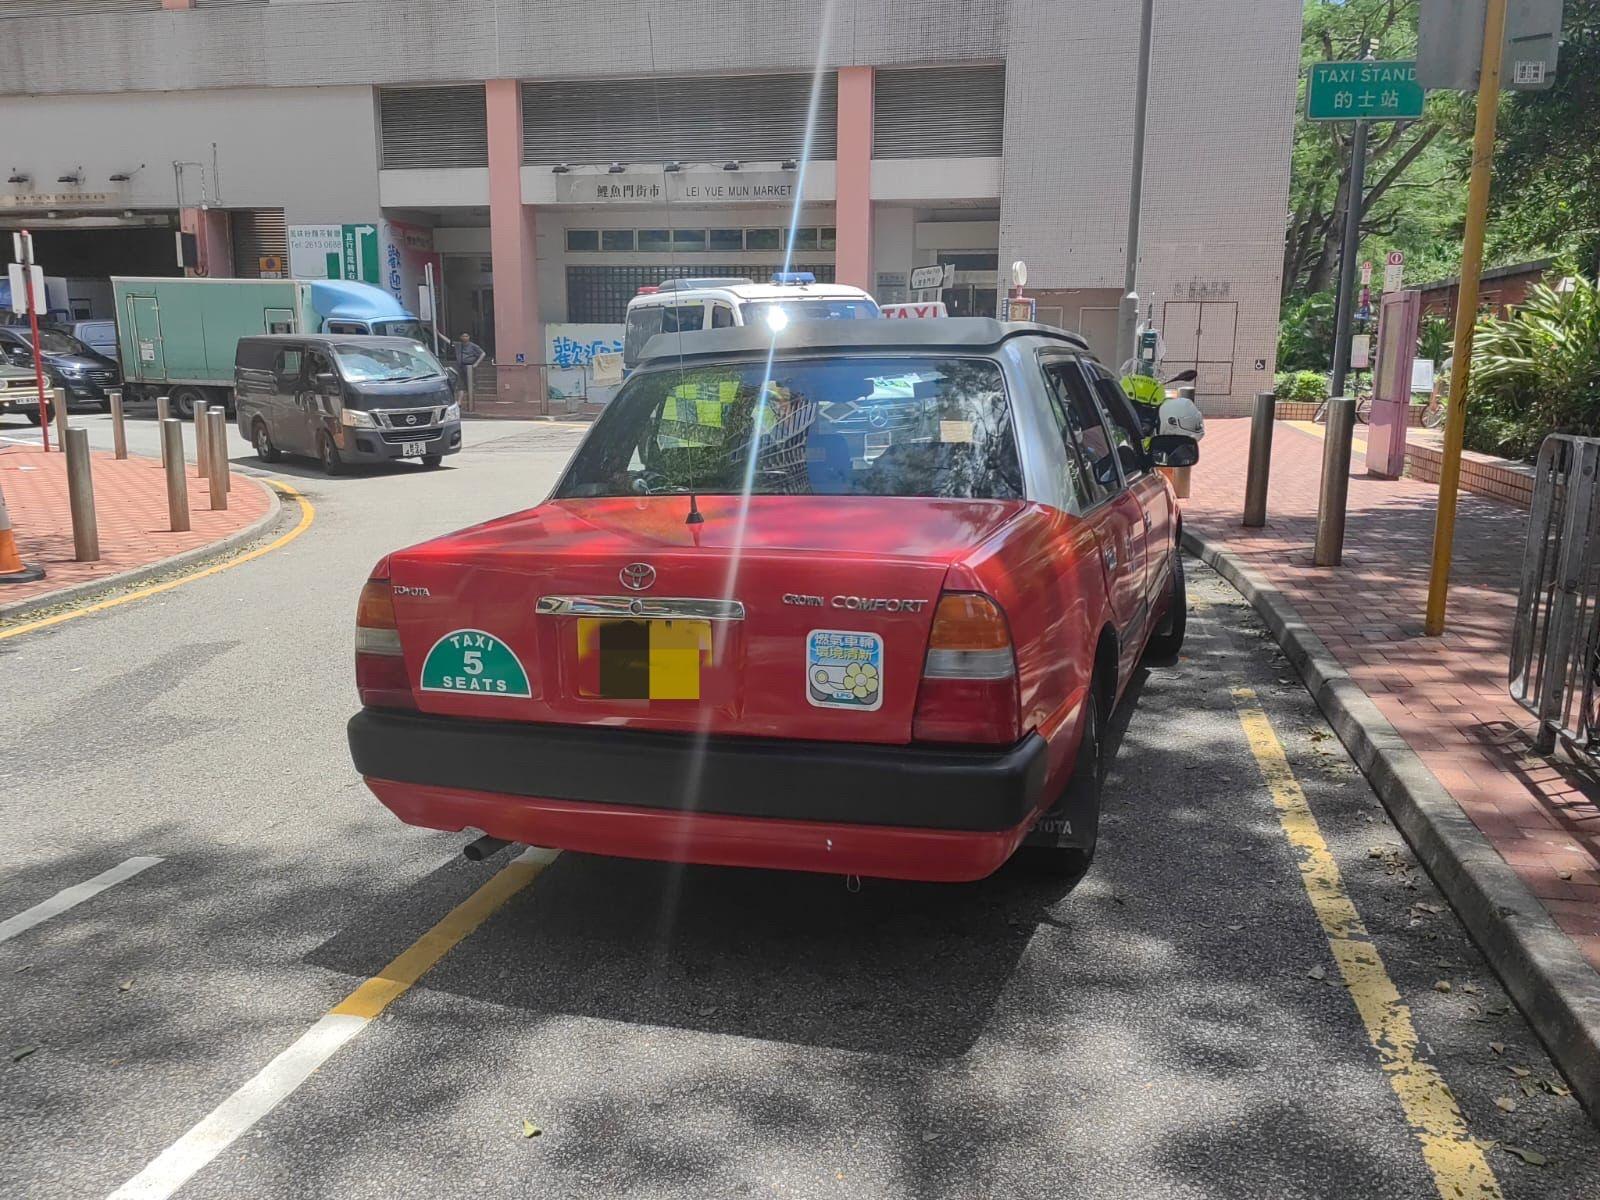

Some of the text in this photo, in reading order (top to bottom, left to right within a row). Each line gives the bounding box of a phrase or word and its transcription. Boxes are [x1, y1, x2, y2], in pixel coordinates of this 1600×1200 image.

[1319, 68, 1417, 83] TAXI STAND
[1334, 89, 1399, 109] 的士站
[597, 184, 660, 198] 鯉魚門街市
[686, 185, 793, 197] LEI YUE MUN MARKET
[882, 306, 939, 319] TAXI
[392, 585, 431, 597] TOYOTA
[782, 593, 929, 613] CROWN COMFORT
[450, 634, 494, 651] TAXI
[815, 633, 874, 649] 燃氣車輛
[463, 650, 484, 675] 5
[443, 675, 507, 692] SEATS
